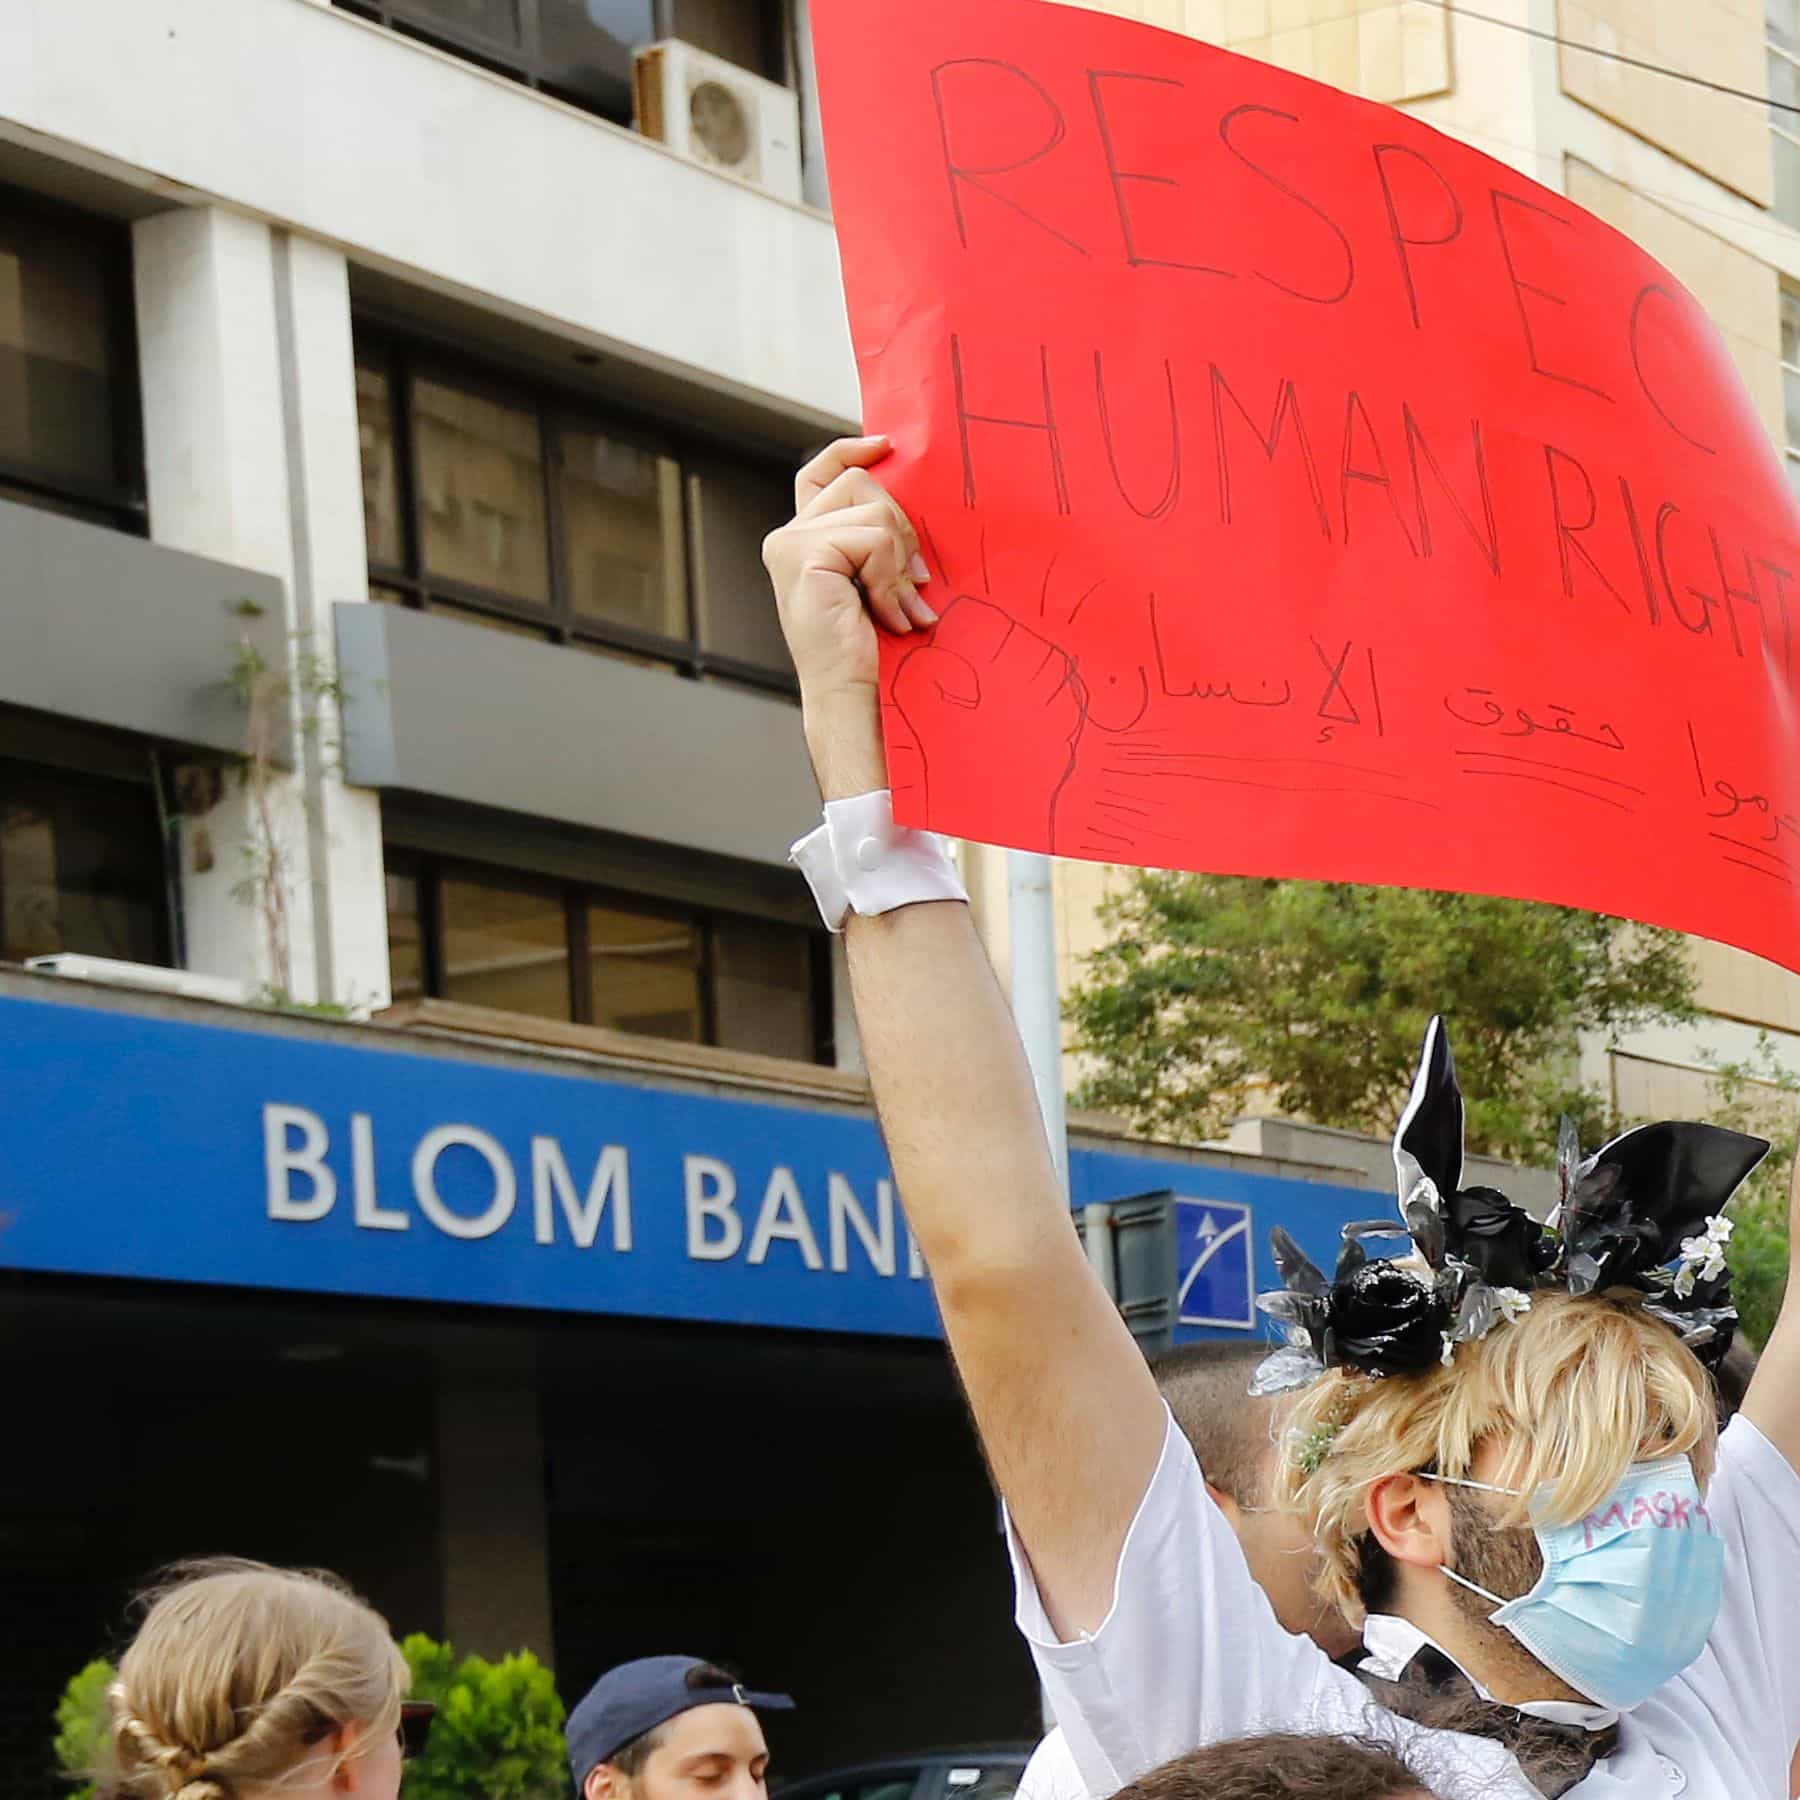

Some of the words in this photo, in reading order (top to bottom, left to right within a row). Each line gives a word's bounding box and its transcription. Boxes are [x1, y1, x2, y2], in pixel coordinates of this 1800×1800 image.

[950, 333, 1502, 578] HUMAN
[1444, 686, 1625, 751] حقوق
[263, 1102, 634, 1253] BLOM
[684, 1154, 923, 1281] BAN
